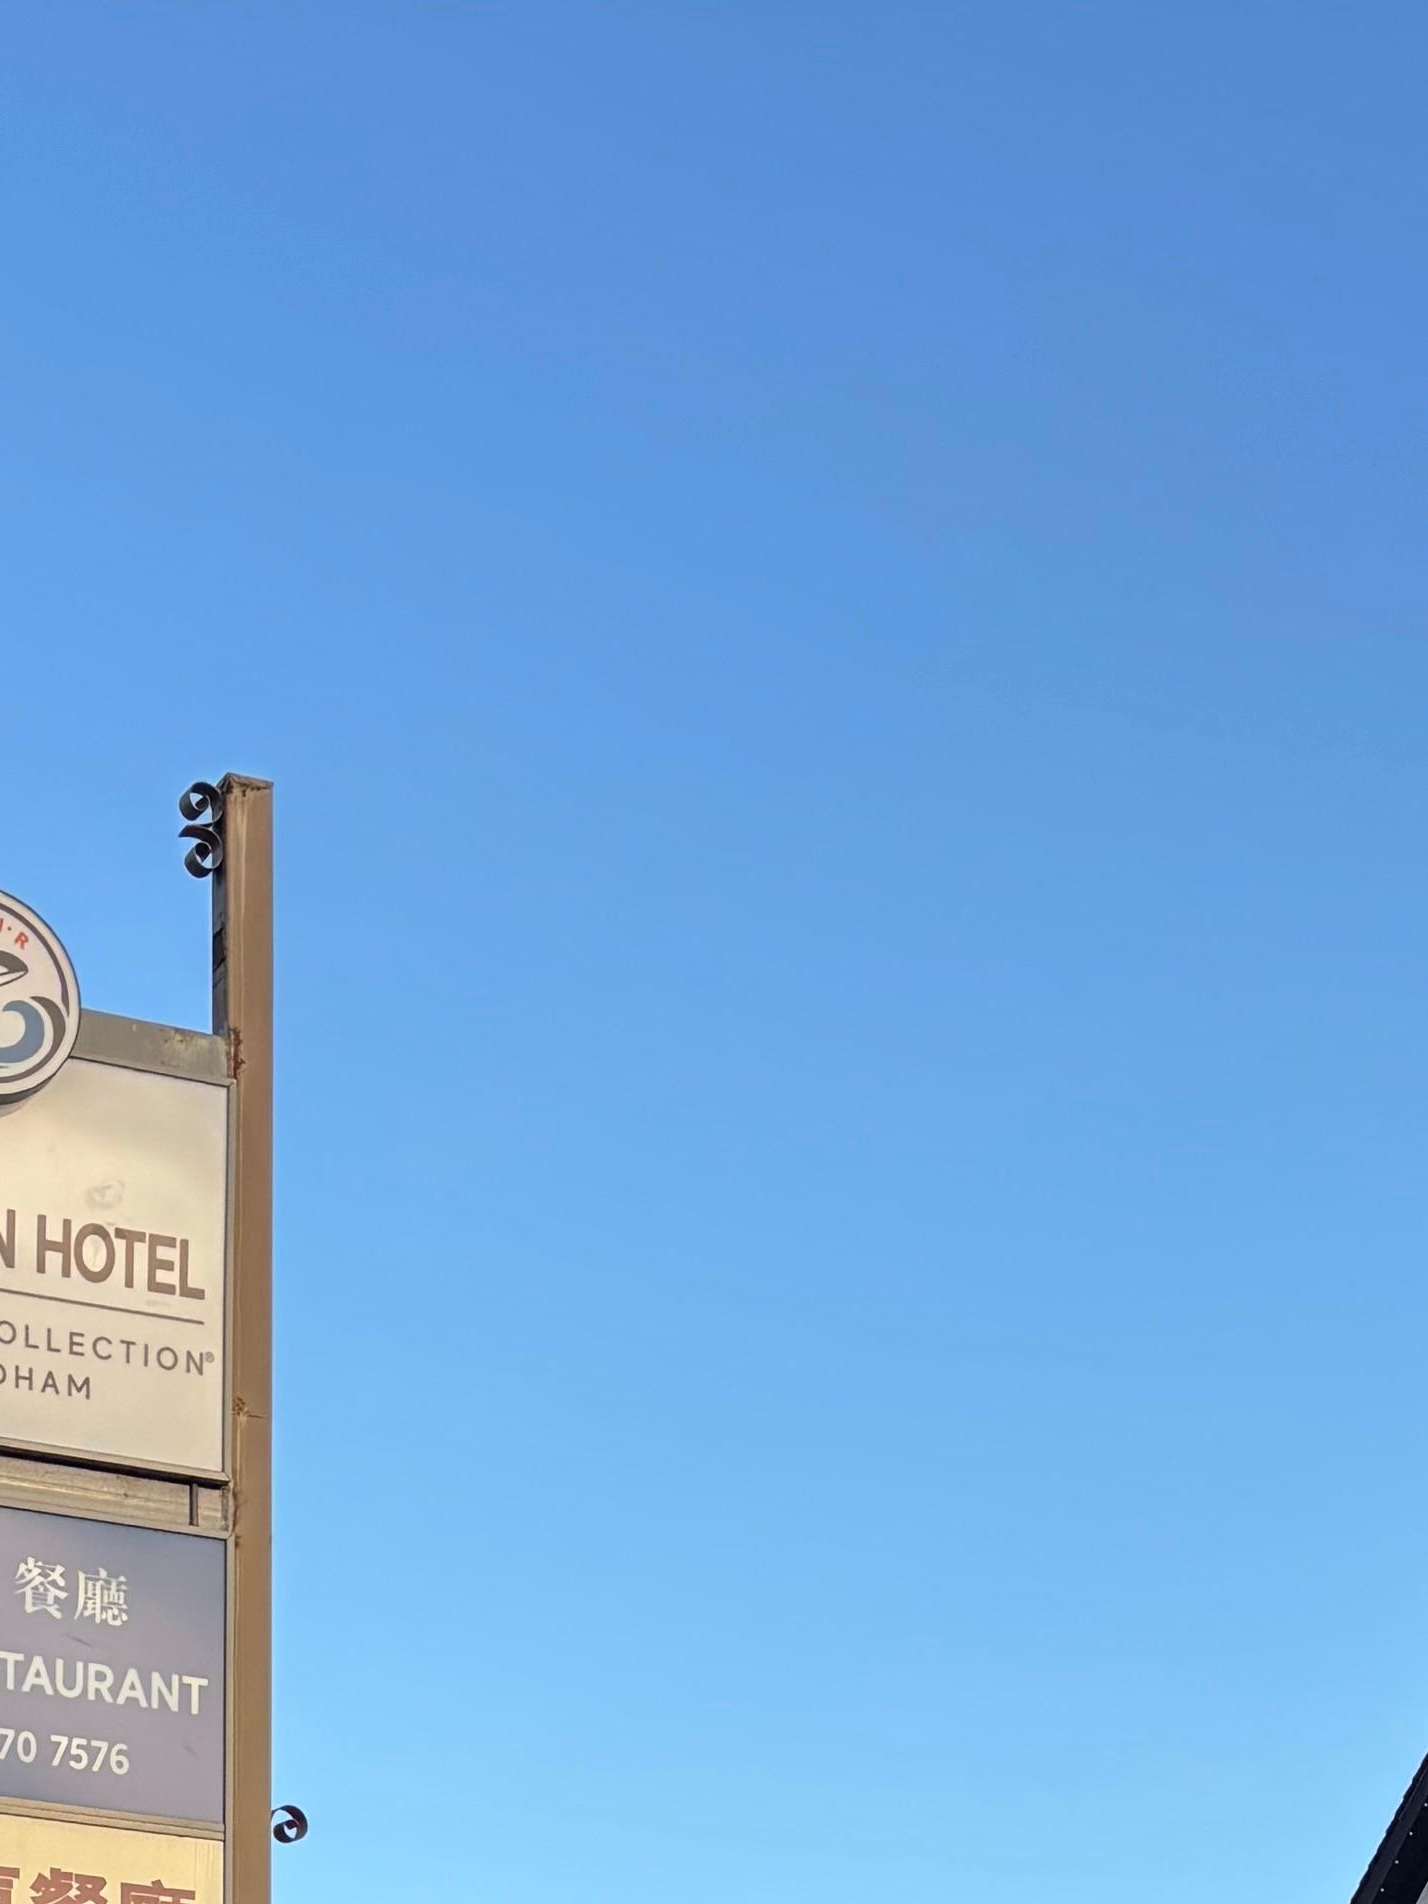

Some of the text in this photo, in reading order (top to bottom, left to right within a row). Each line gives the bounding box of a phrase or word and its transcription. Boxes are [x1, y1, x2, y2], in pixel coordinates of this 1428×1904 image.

[36, 1215, 205, 1300] HOTEL
[14, 1557, 129, 1626] 餐廳
[50, 1734, 130, 1775] 7576
